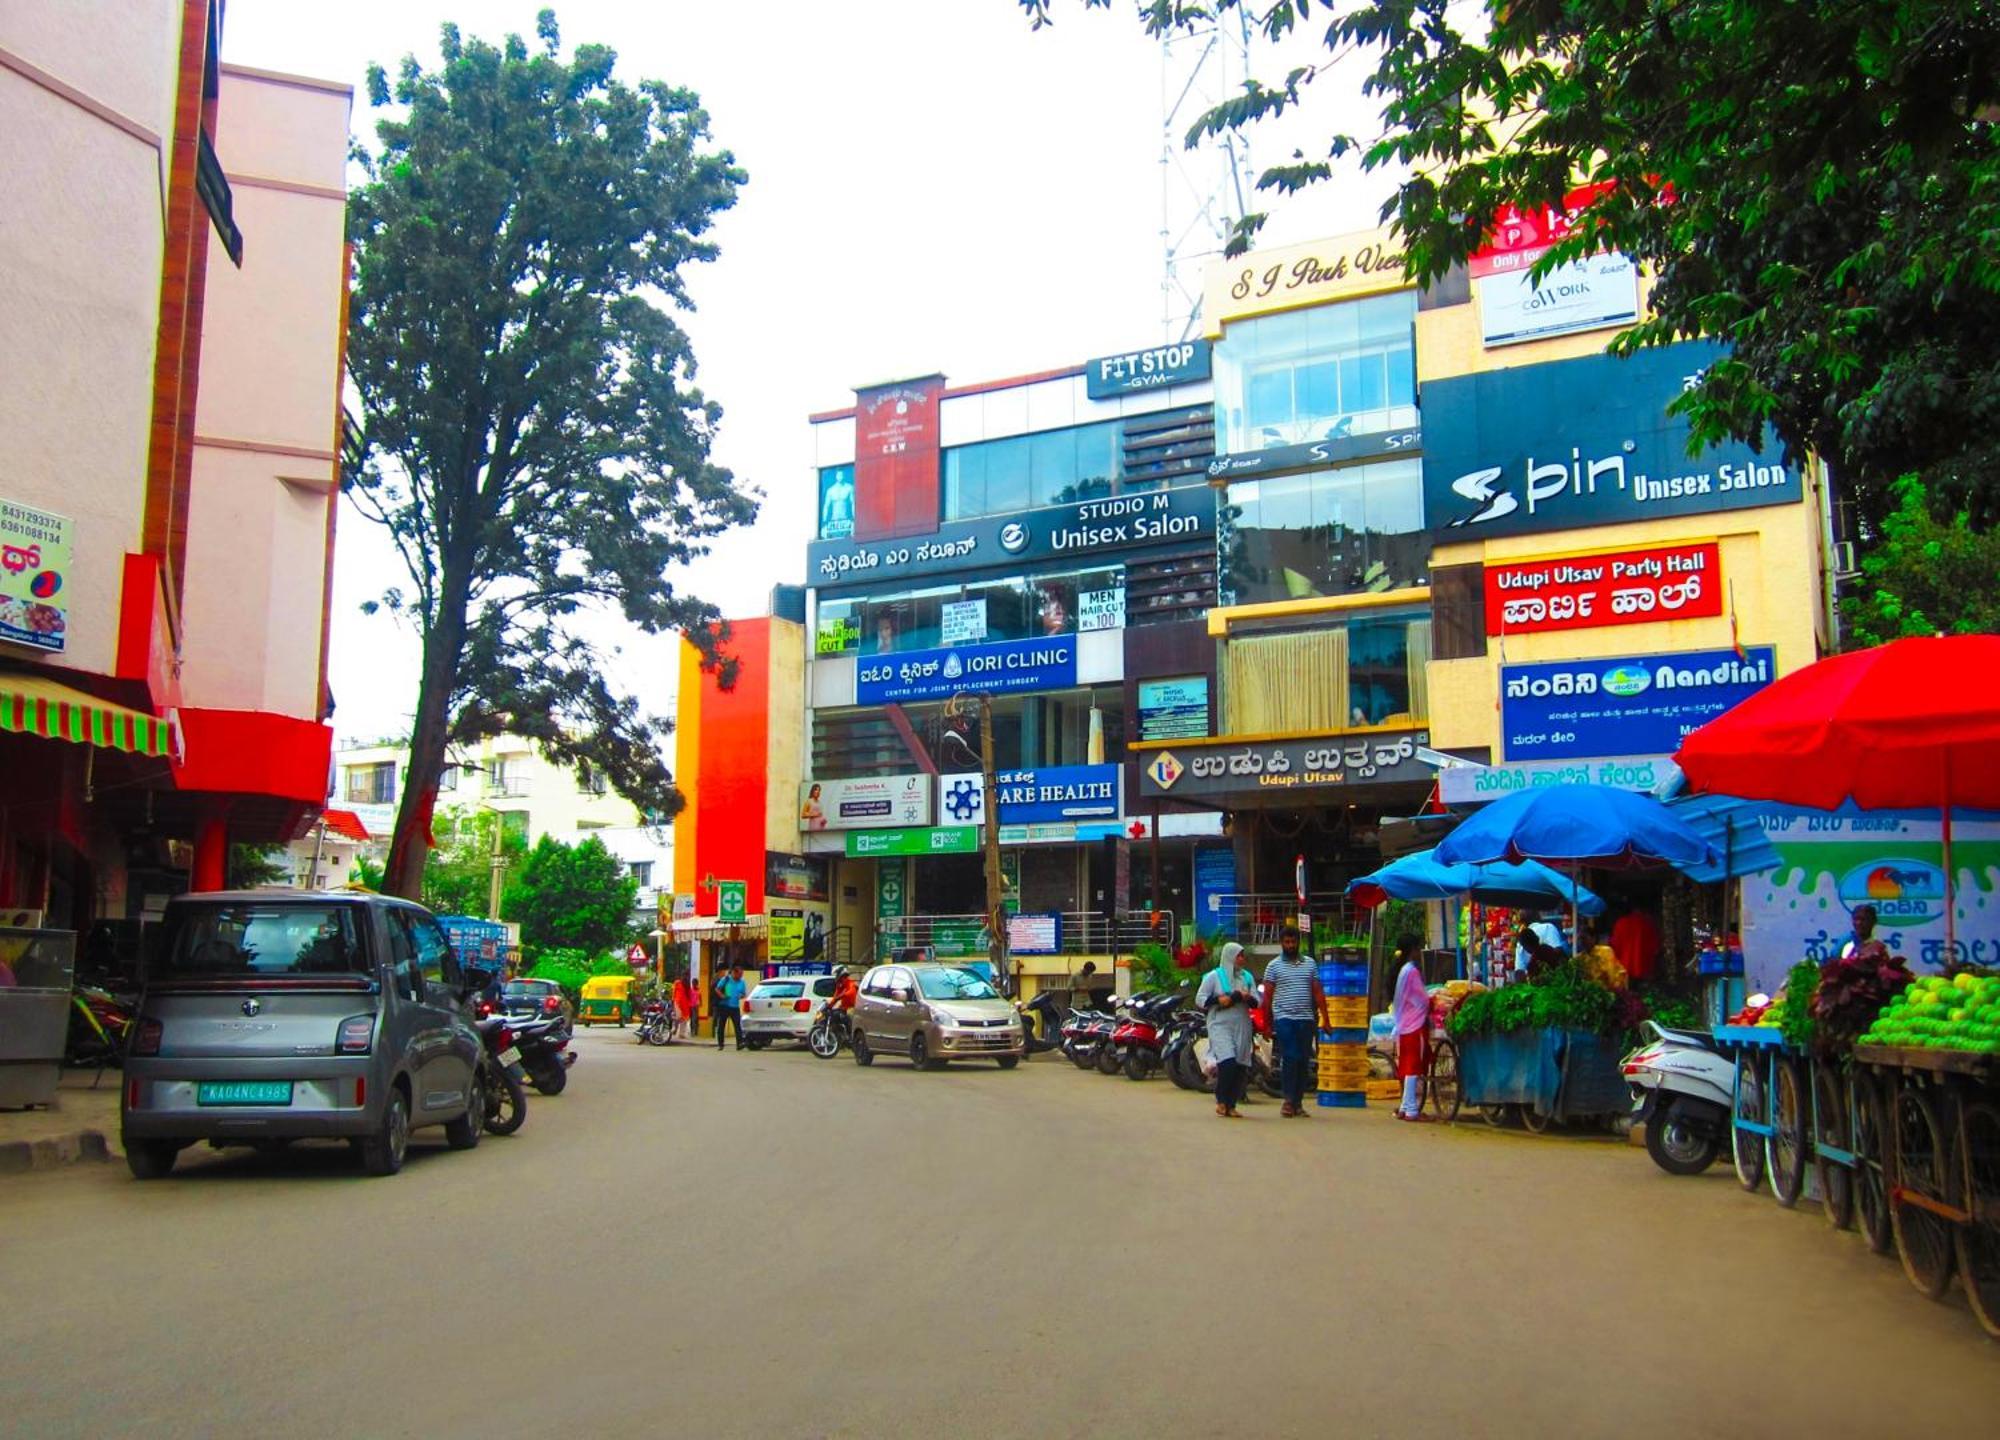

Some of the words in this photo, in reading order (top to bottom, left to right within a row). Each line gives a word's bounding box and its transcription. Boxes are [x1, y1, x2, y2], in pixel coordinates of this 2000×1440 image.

[1286, 256, 1348, 289] Park
[1492, 252, 1520, 269] Only
[1101, 354, 1139, 381] FIT
[1142, 345, 1194, 373] STOP
[1131, 373, 1167, 388] GYM
[1633, 470, 1712, 502] Unisex
[1718, 461, 1787, 491] Salon
[1079, 498, 1145, 520] STUDIO
[1152, 494, 1169, 510] M
[1051, 525, 1128, 550] Unisex
[1133, 513, 1199, 539] Salon
[885, 548, 910, 564] ಎಂ
[916, 534, 976, 561] ಸಲೂನ್
[1498, 570, 1549, 590] Udupi
[1553, 565, 1603, 584] Utsav
[1612, 557, 1662, 579] Party
[1666, 551, 1704, 572] Hall
[1089, 590, 1116, 604] MEN
[1610, 575, 1701, 615] ಹಾಲ್
[1080, 604, 1104, 616] HAIR
[1105, 601, 1124, 613] CUT
[820, 640, 839, 652] CUT
[967, 655, 1001, 673] IORI
[1006, 648, 1068, 668] CLINIC
[885, 687, 911, 697] CENTRE
[930, 685, 950, 693] JOINT
[953, 679, 1004, 691] REPLACEMENT
[1006, 676, 1040, 686] SURGERY
[1507, 672, 1597, 698] ನಂದಿನಿ
[1512, 731, 1547, 745] ಮದರ್
[1551, 731, 1576, 743] ಡೇರಿ
[1191, 746, 1291, 778] ಉಡುಪಿ
[1304, 736, 1413, 777] ಉತ್ಸವ್
[1259, 773, 1300, 787] Udupi
[1303, 771, 1344, 784] Utsav
[1474, 767, 1527, 792] ನಂದಿನಿ
[1599, 760, 1657, 788] ಕೇಂದ್ರ
[995, 787, 1036, 804] ARE
[1039, 782, 1113, 802] HEALTH
